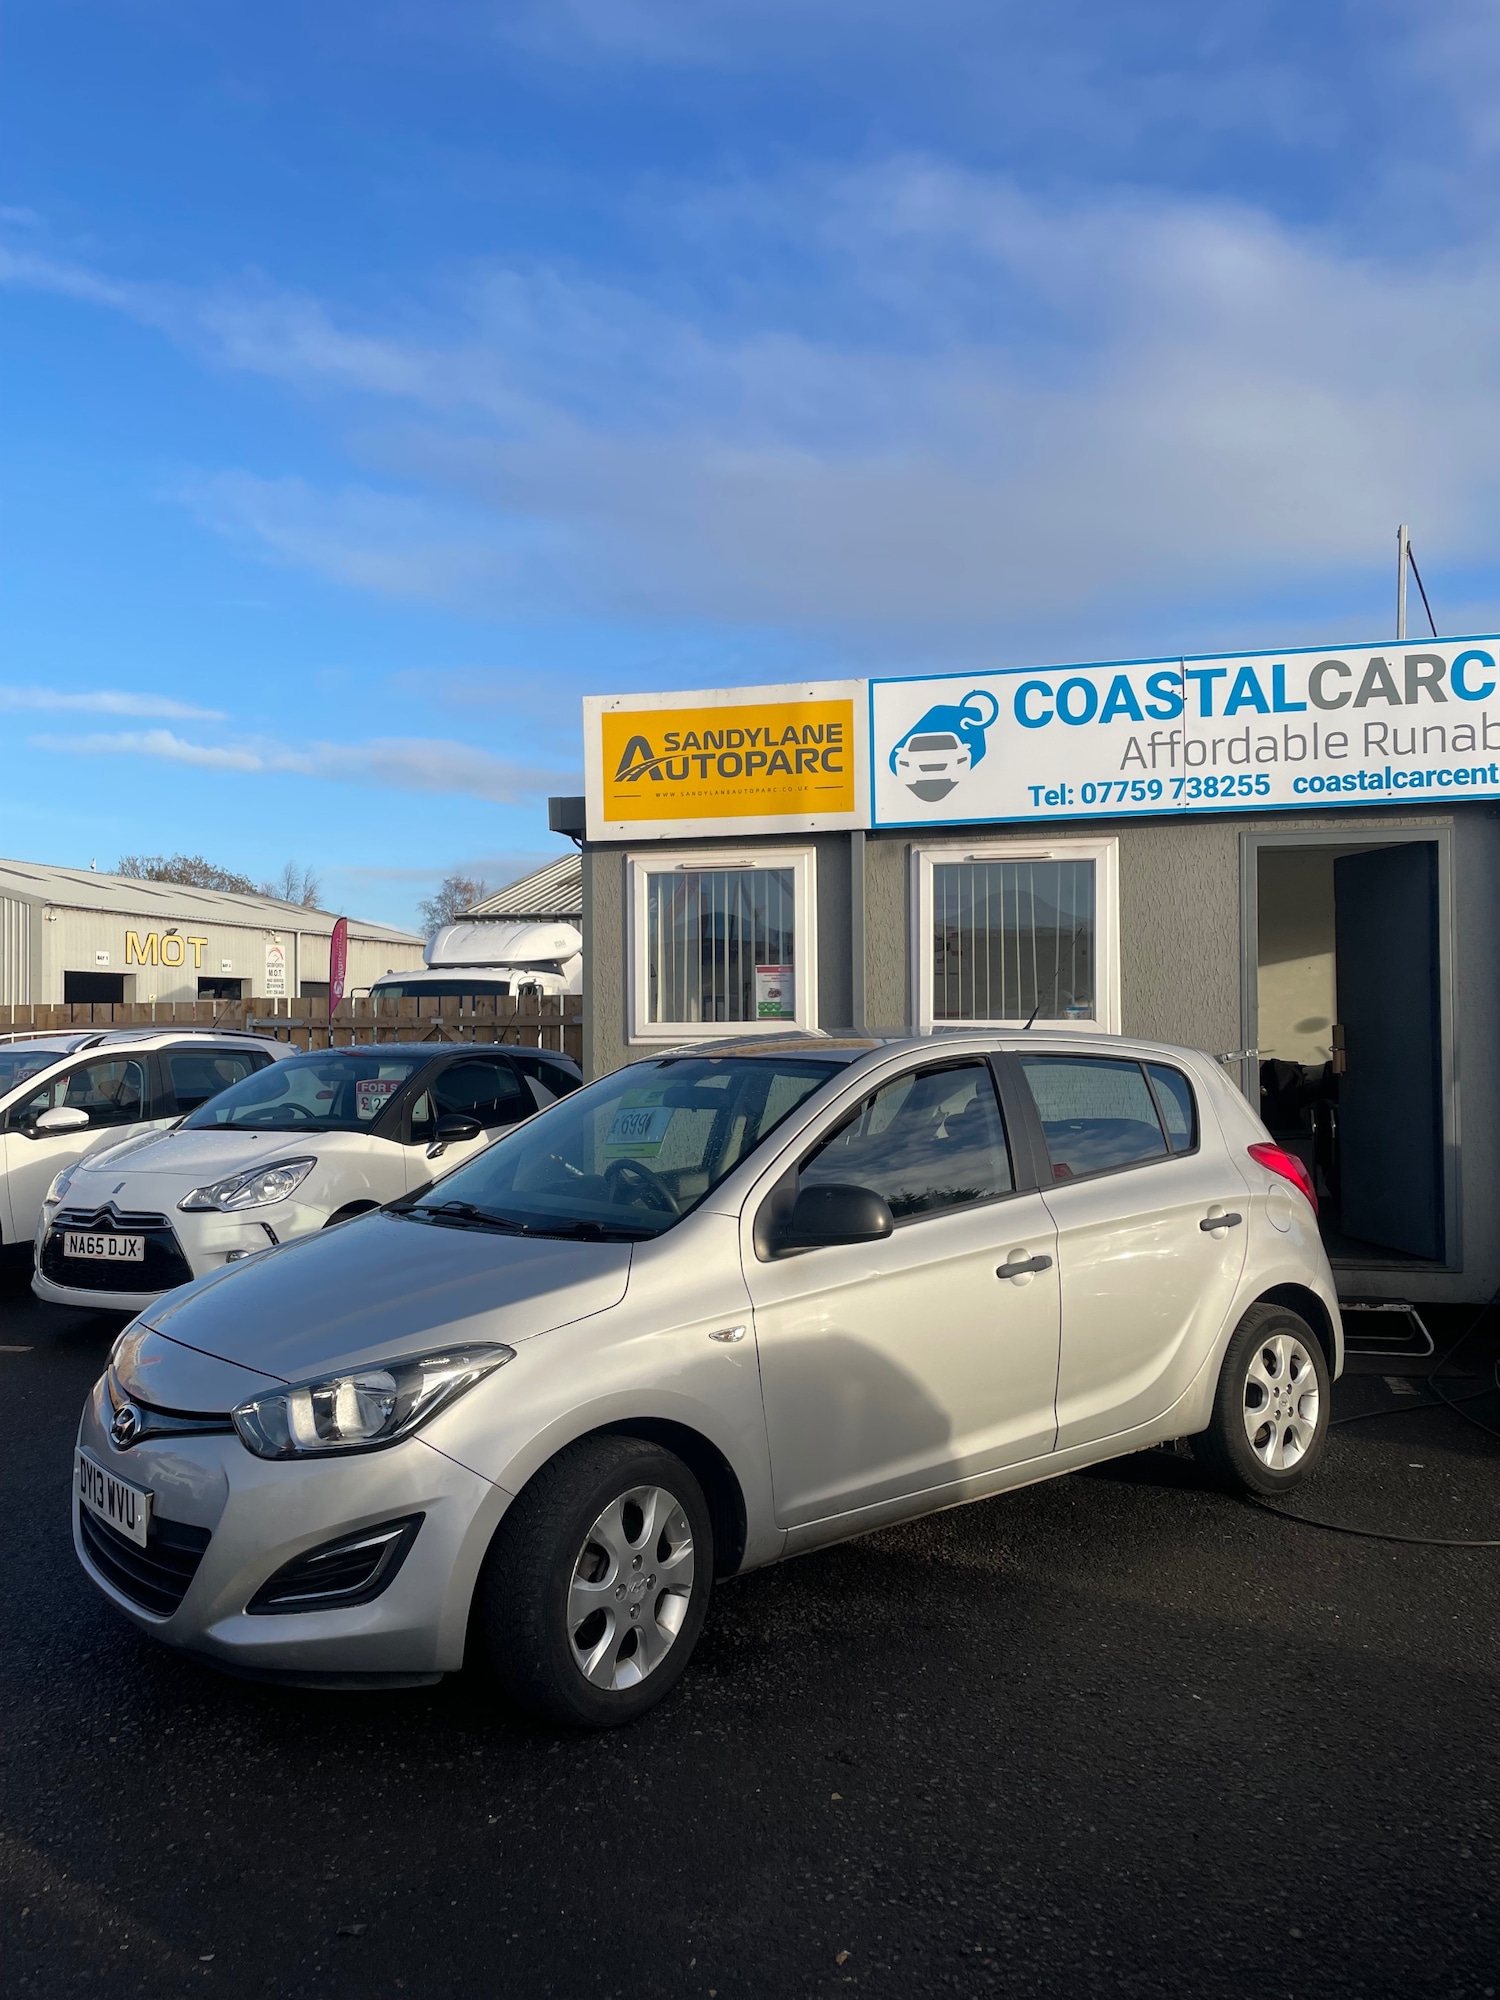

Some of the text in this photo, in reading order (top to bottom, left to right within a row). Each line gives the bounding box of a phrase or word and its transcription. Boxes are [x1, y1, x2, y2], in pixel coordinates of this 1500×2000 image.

[664, 723, 843, 751] SANDYLANE
[1120, 712, 1500, 770] Affordable Runab
[614, 735, 843, 782] AUTOPARC
[1028, 763, 1500, 806] Tel: 07759 738255 coastalcarcent
[125, 931, 208, 968] MOT
[361, 1083, 387, 1093] FOR
[69, 1235, 137, 1257] NA65 DJX
[80, 1456, 135, 1530] DY13 WVU
